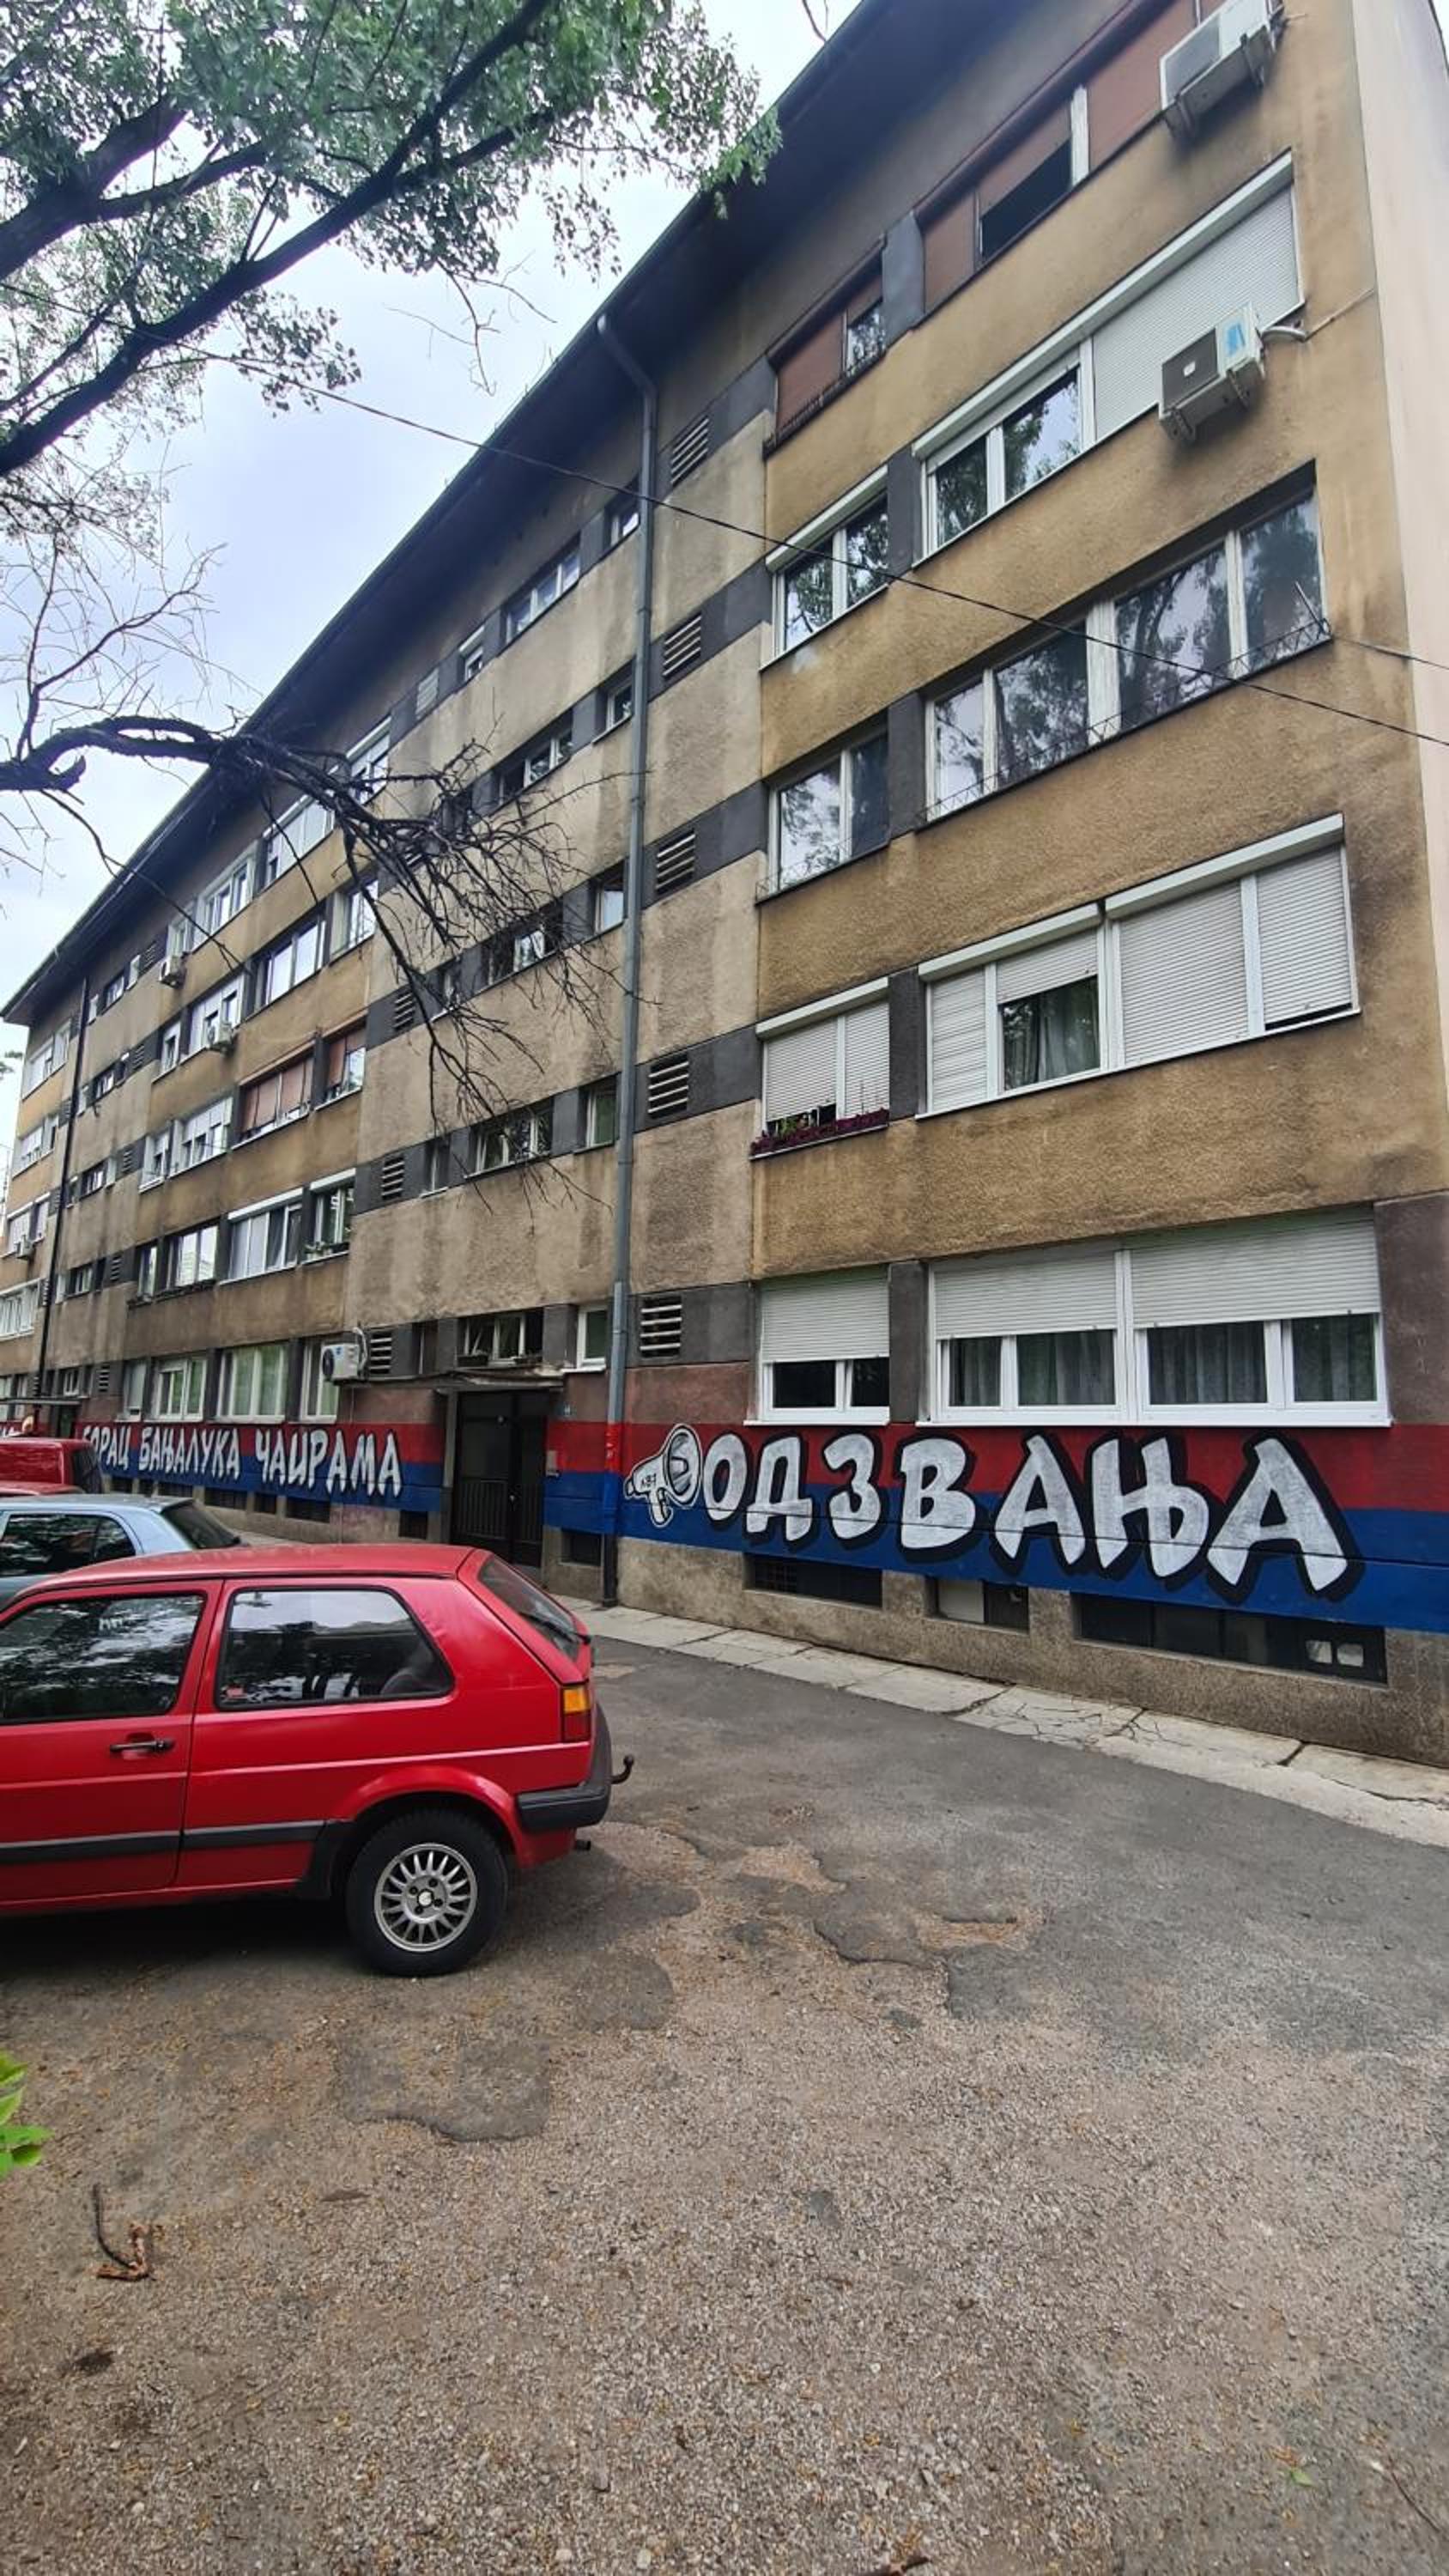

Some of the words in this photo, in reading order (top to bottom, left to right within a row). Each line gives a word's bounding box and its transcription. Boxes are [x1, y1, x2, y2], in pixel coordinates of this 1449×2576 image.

[138, 1426, 240, 1479] БАЊАЛУКА
[255, 1428, 402, 1498] ЧАИРАМА
[702, 1431, 1351, 1594] ОДЗВАЊА
